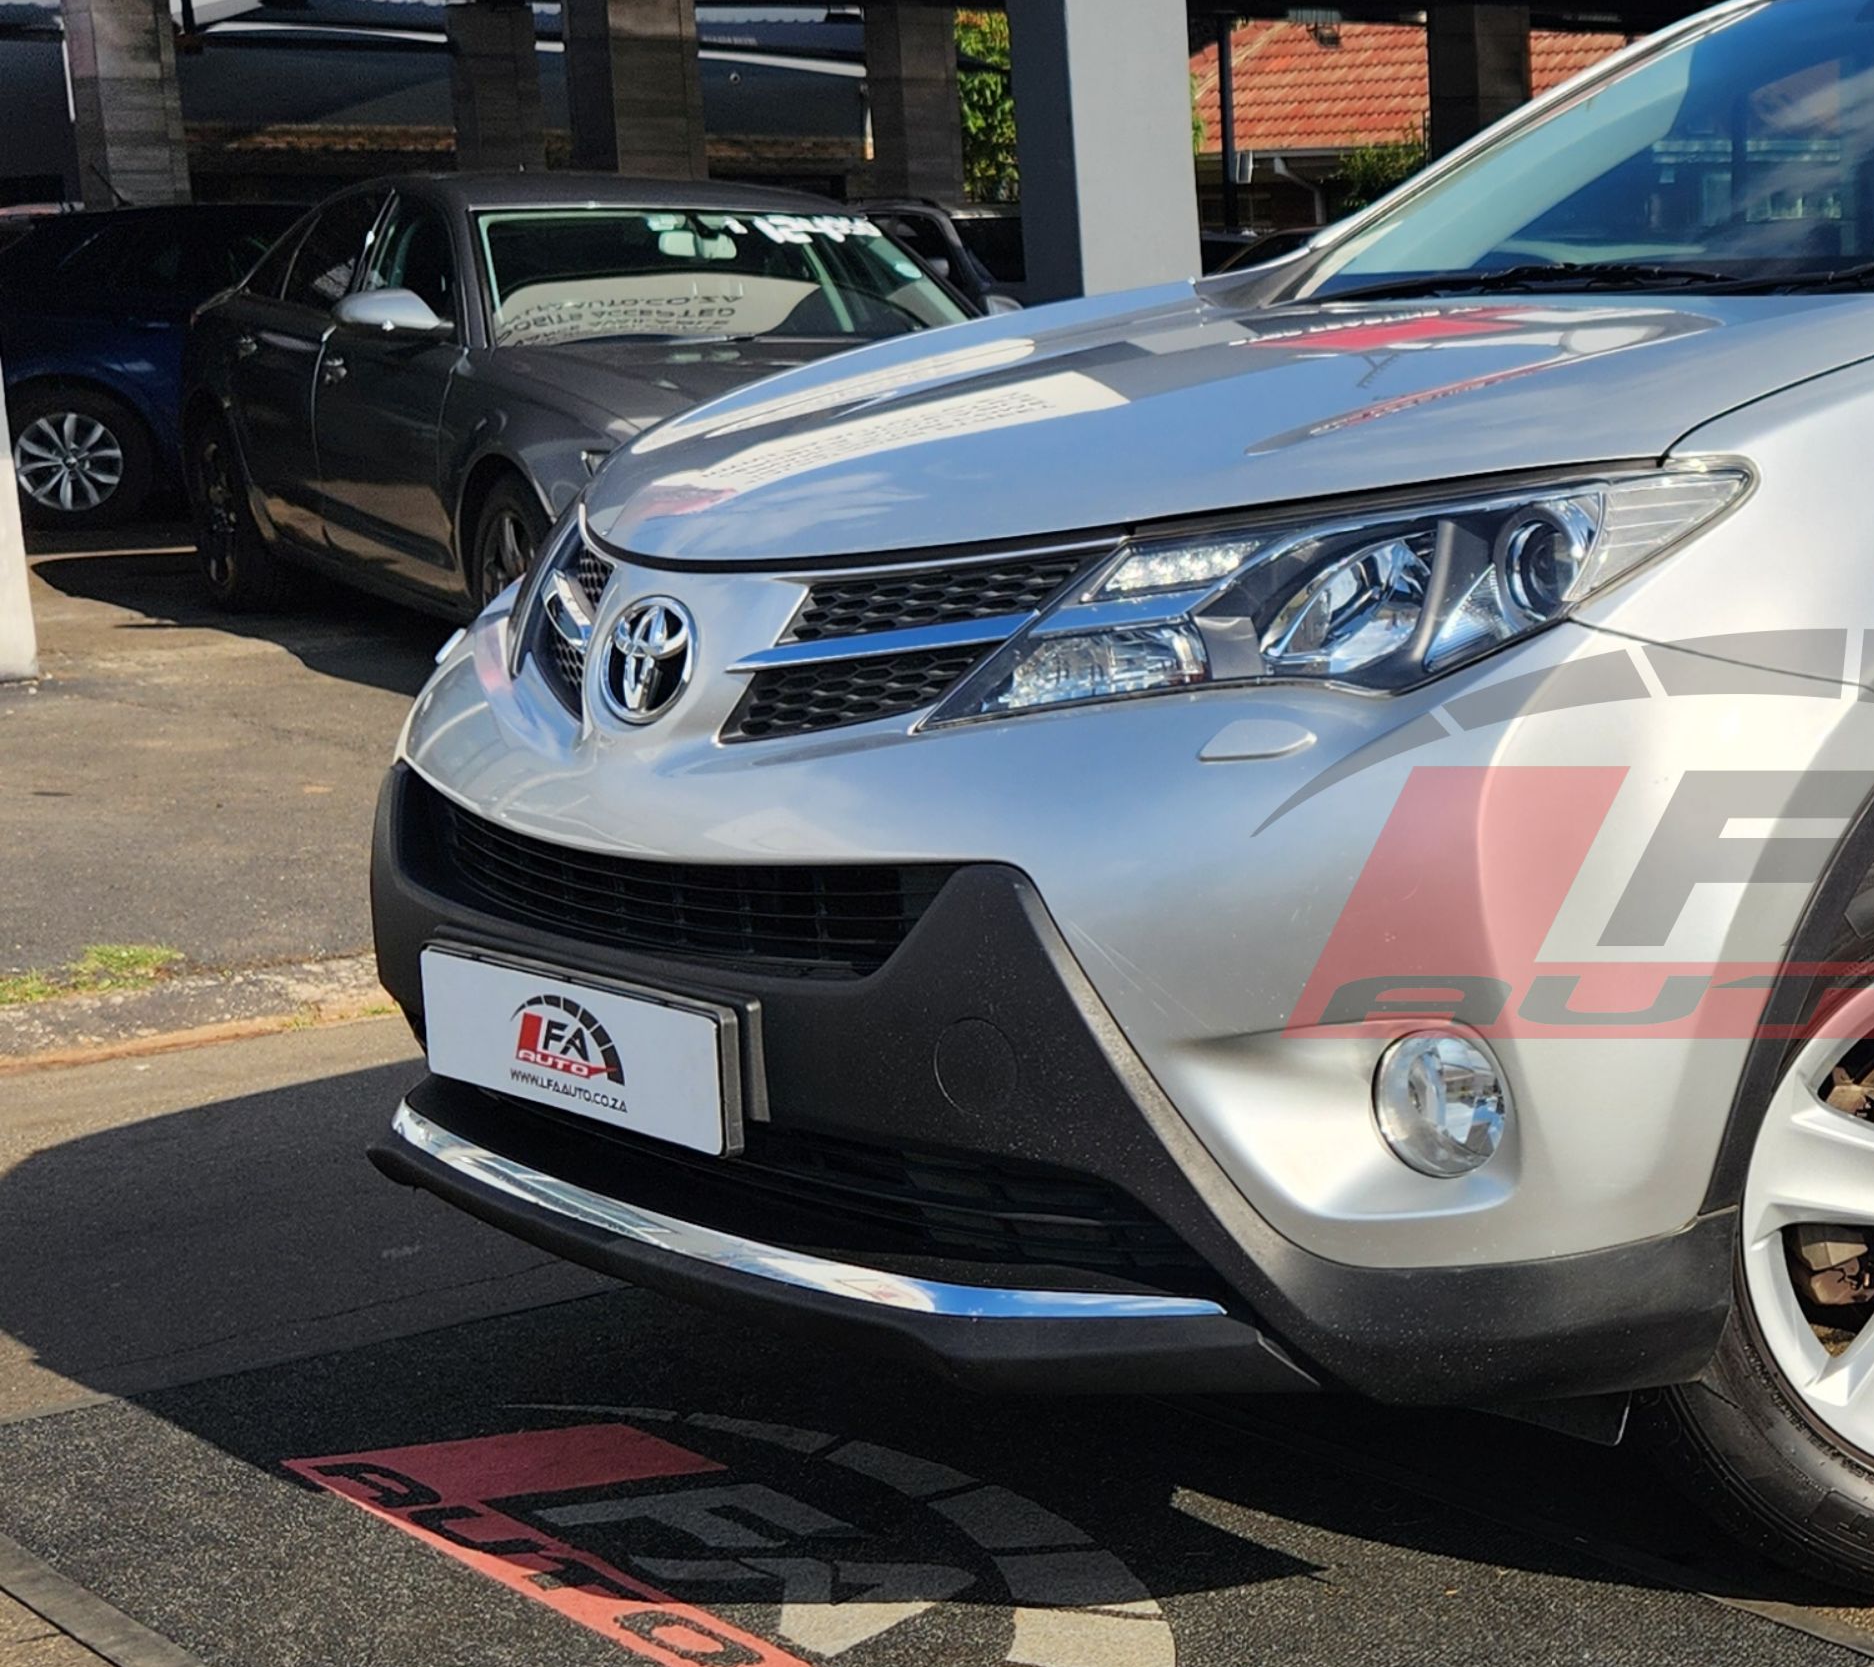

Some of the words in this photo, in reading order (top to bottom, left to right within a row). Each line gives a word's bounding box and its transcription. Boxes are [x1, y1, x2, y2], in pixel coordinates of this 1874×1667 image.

[516, 1012, 590, 1063] LFA
[518, 1049, 589, 1077] AUTO
[510, 1068, 628, 1114] WWW.LFAAUTO.CO.ZA
